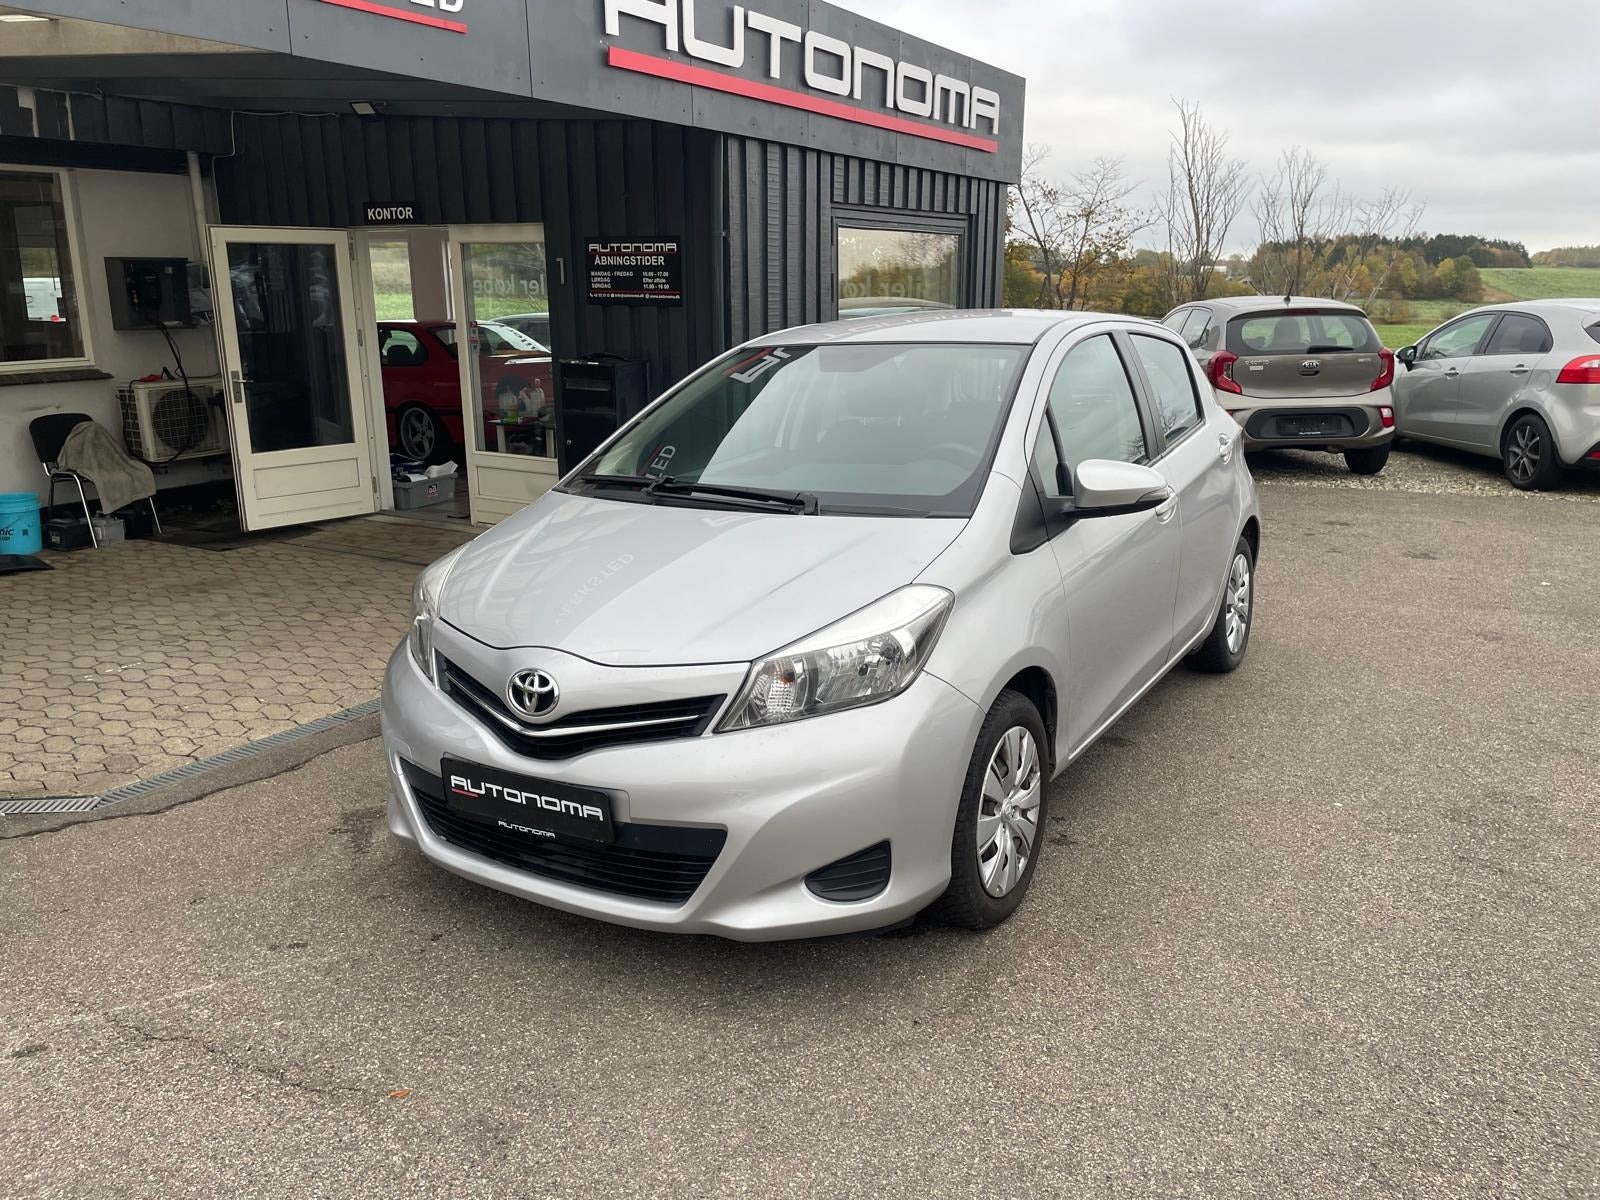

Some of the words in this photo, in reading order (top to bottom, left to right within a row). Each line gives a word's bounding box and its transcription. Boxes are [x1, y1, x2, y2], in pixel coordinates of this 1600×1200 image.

[605, 0, 1000, 135] AUTONOMA
[368, 207, 414, 220] KONTOR
[588, 243, 677, 252] AUTONOMA
[594, 254, 665, 266] ÅBNINGSTIDER
[450, 775, 604, 822] AUTONOMA
[498, 820, 556, 839] AUTONOMA
